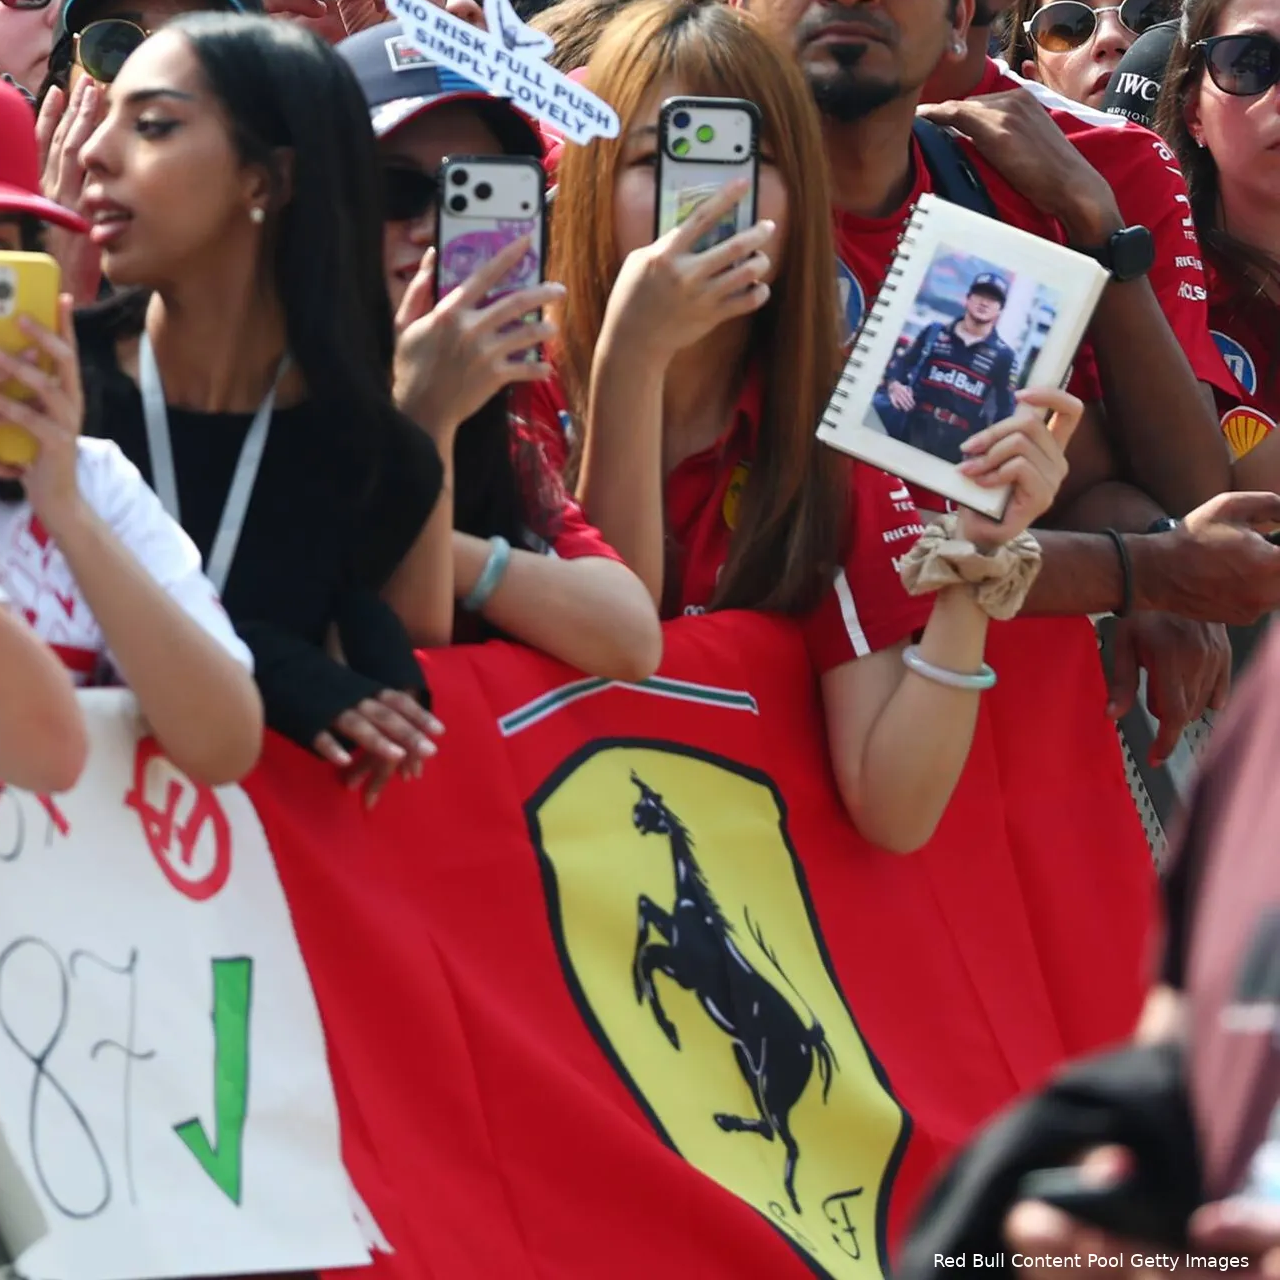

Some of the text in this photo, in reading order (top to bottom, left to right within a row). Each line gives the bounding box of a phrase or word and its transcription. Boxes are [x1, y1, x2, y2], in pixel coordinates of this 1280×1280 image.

[415, 28, 587, 134] SIMPLY LOVELY
[434, 18, 489, 56] RISK
[494, 49, 547, 92] FULL
[553, 82, 611, 130] PUSH
[1115, 72, 1161, 101] IWC
[883, 523, 925, 544] RICH
